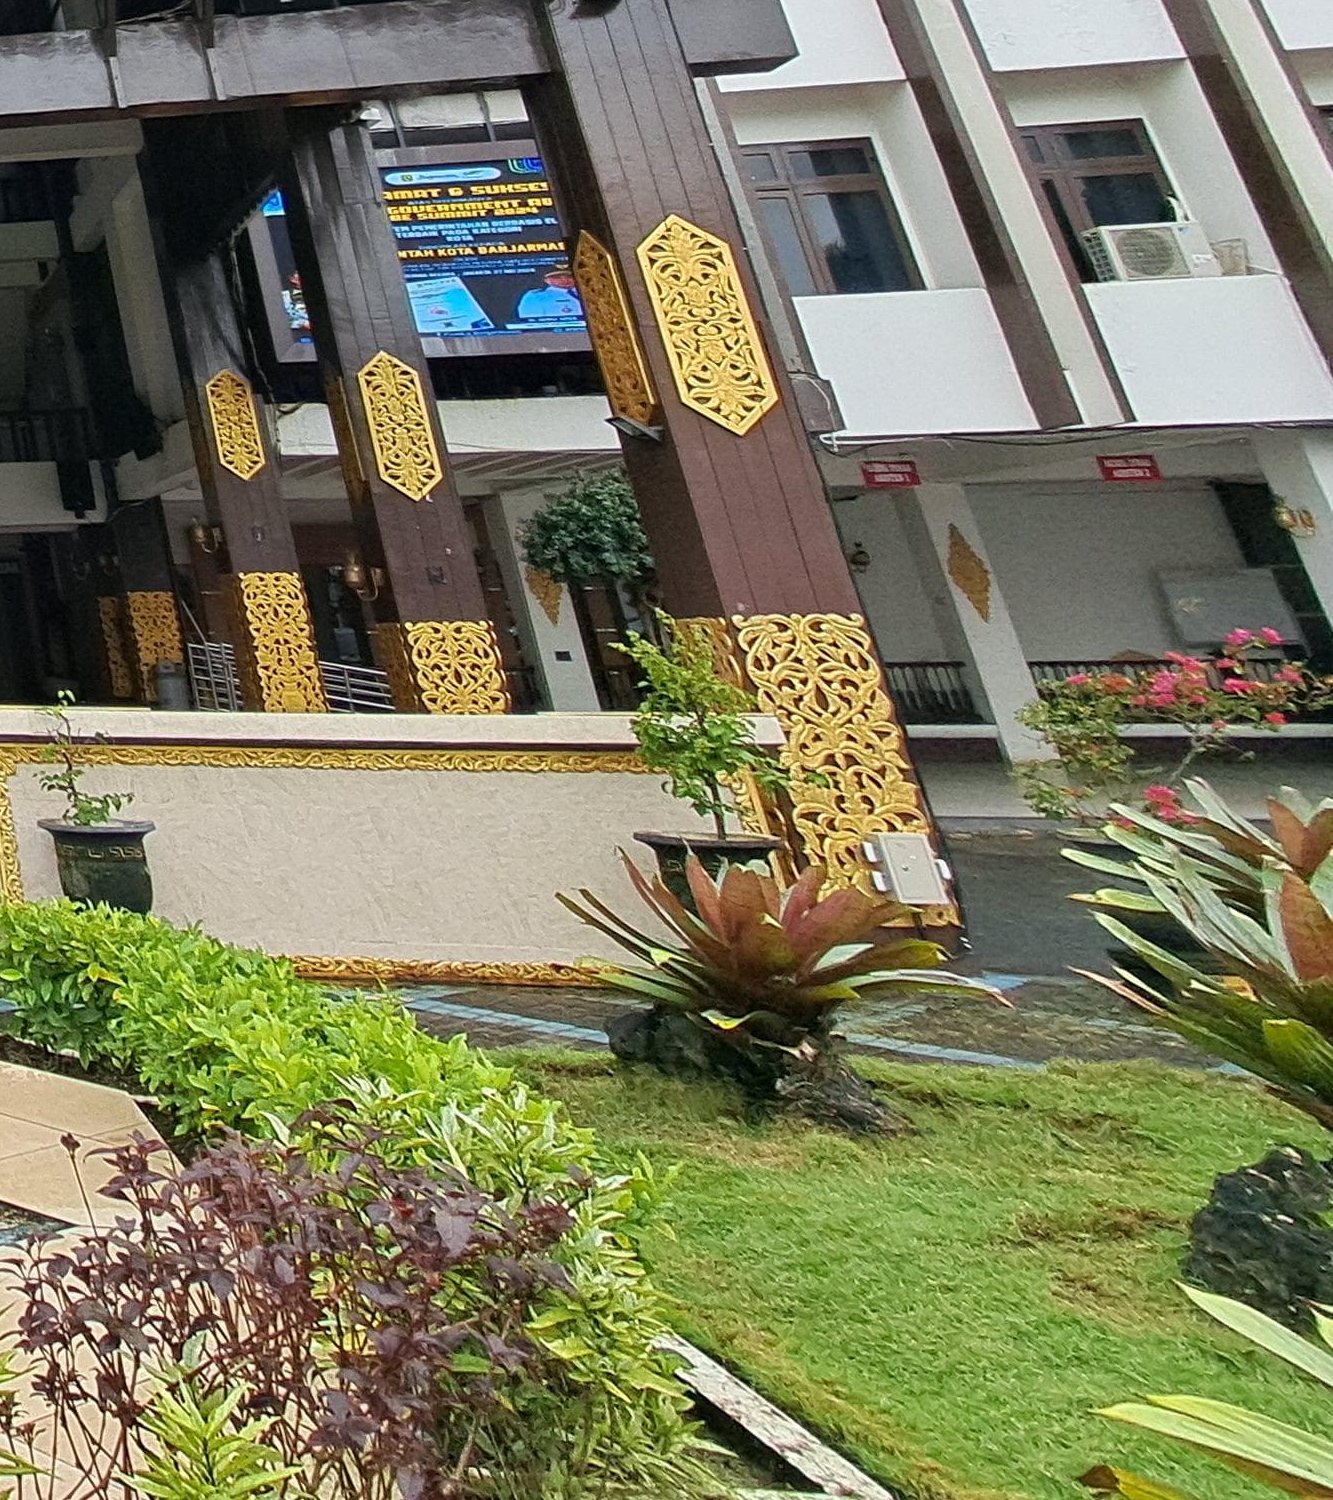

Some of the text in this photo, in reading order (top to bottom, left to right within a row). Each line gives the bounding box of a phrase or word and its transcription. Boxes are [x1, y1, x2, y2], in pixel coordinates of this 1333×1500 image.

[383, 188, 442, 201] AMAT
[387, 199, 523, 215] GOVERNMENT
[398, 250, 434, 260] NTAH
[437, 247, 475, 257] KOTA
